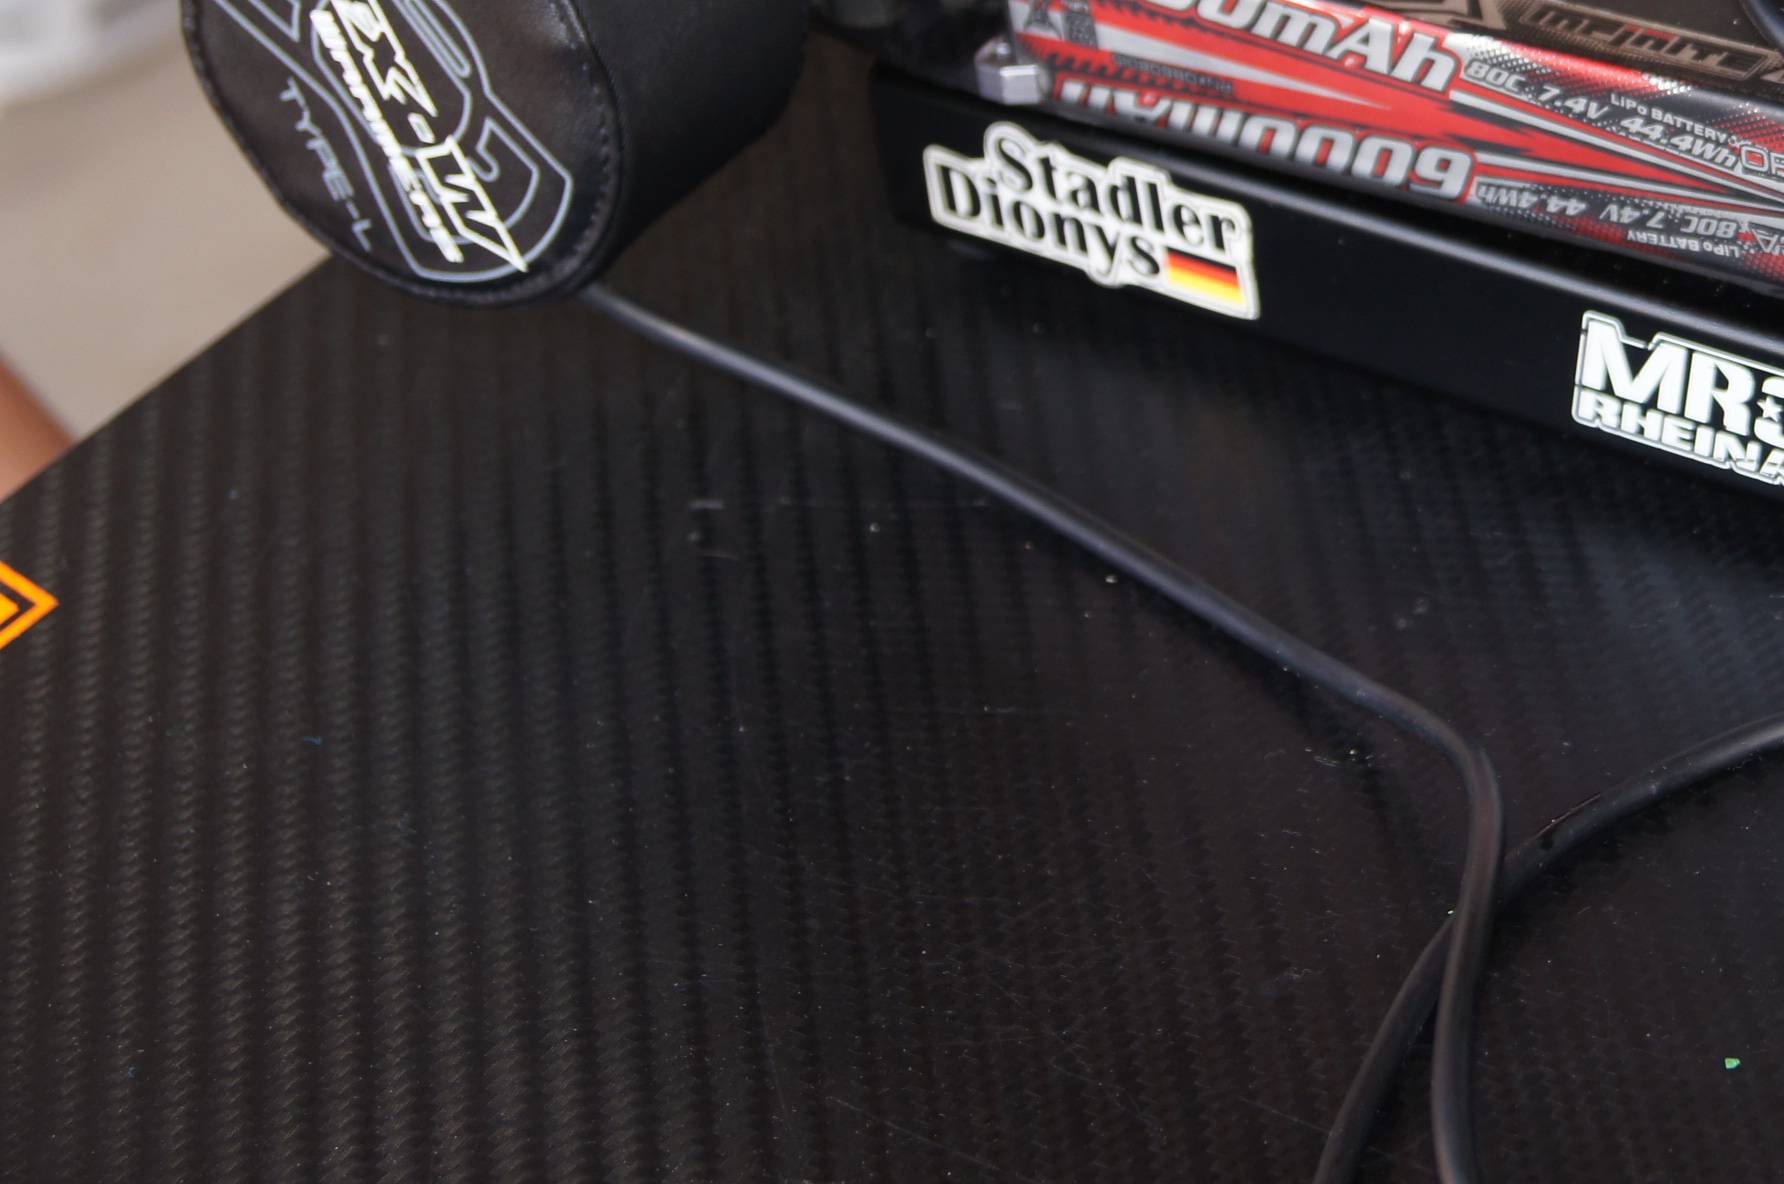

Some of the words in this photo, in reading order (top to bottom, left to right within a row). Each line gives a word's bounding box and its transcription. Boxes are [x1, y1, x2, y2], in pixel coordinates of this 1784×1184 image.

[1466, 61, 1526, 92] 80C
[1537, 85, 1610, 120] 7.4V
[1619, 115, 1738, 167] 44.4Wh
[1651, 107, 1728, 145] BATTERY
[279, 77, 373, 252] TYPE-L
[1000, 137, 1236, 254] Stadler
[1478, 184, 1587, 216] 44.4Wh
[939, 165, 1160, 276] Dionys
[1600, 203, 1665, 229] 7.4V
[1681, 216, 1739, 239] 80C
[1627, 229, 1700, 253] BATTERY
